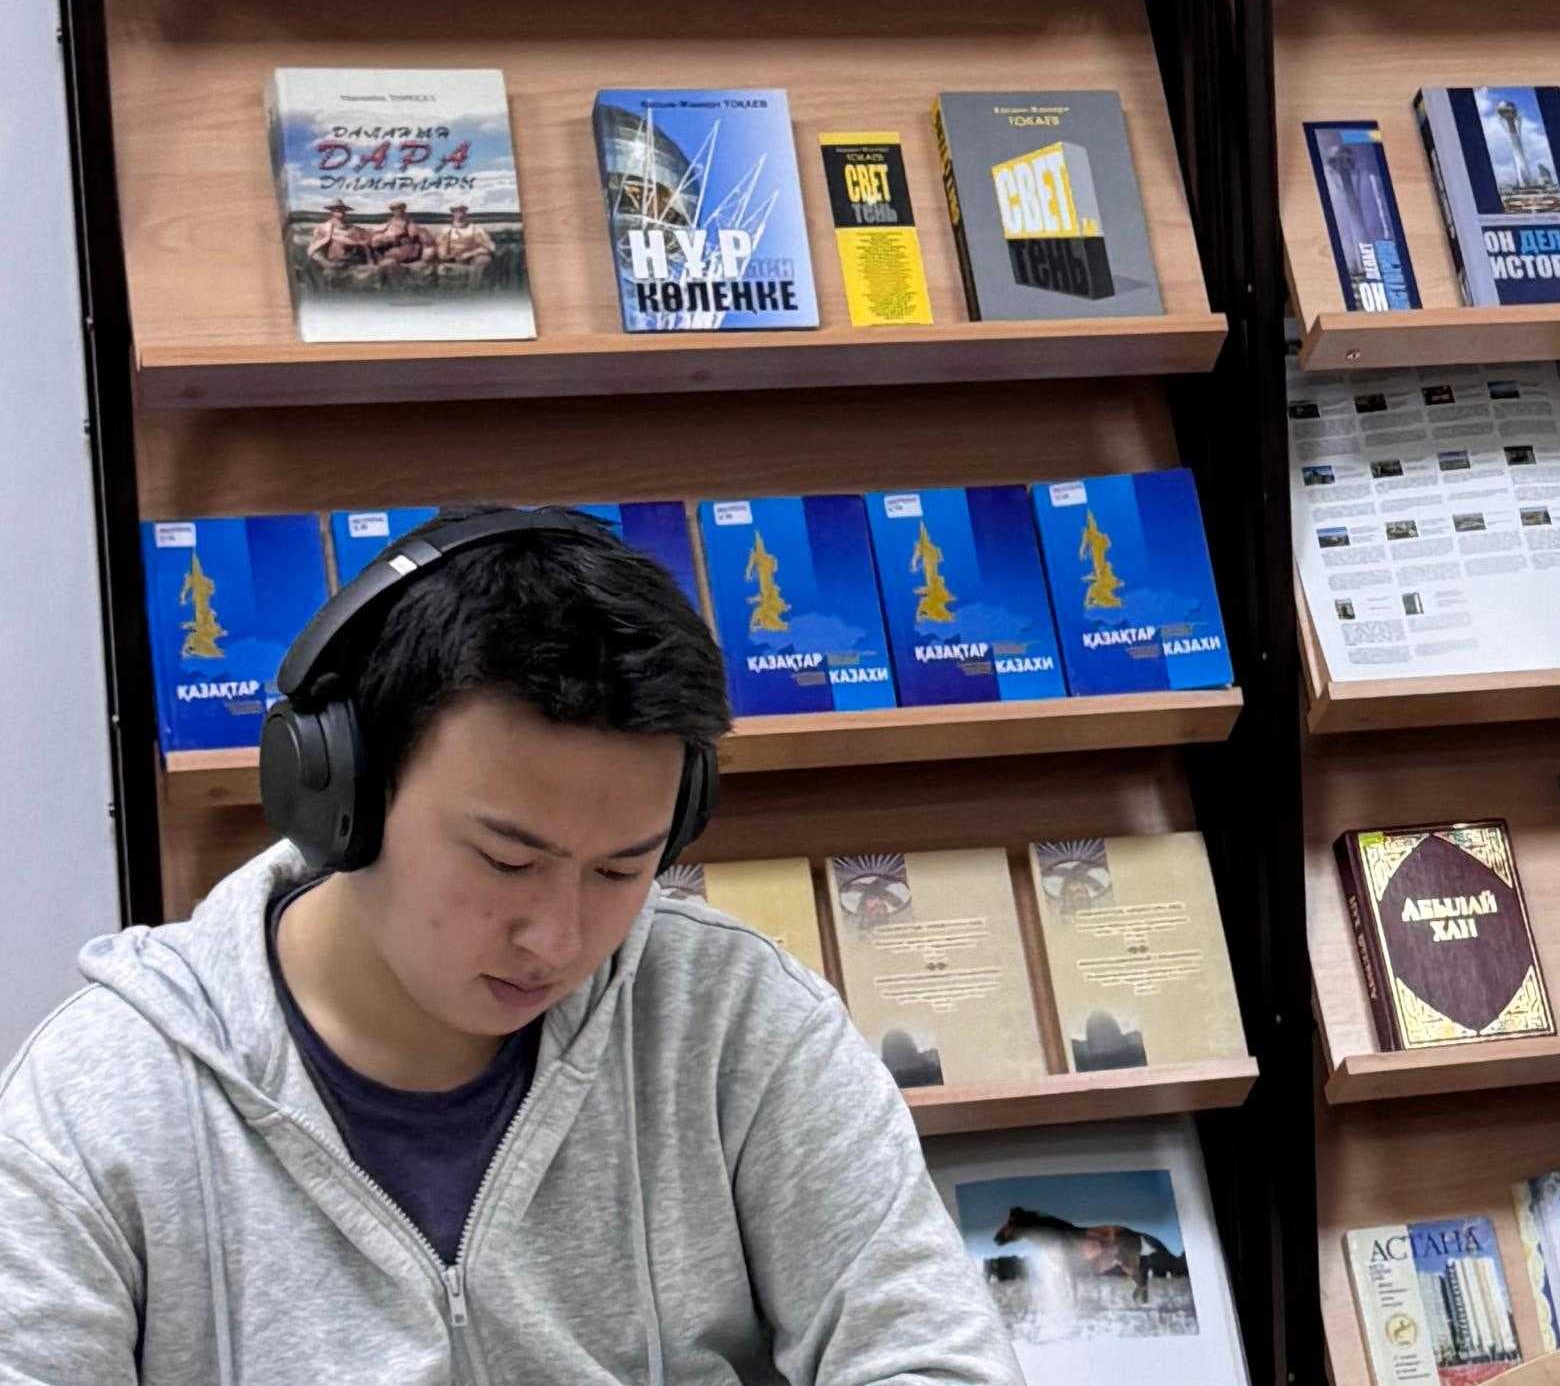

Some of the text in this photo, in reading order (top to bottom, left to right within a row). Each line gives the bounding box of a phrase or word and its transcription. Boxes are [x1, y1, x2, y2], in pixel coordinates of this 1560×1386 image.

[844, 163, 893, 204] СВЕТ
[1485, 230, 1516, 253] ОН
[628, 229, 751, 279] НҰР
[636, 280, 799, 316] КӨЛЕҢКЕ
[1082, 626, 1157, 650] ҚАЗАҚТАР
[1162, 635, 1221, 657] КАЗАХИ
[747, 651, 823, 674] ҚАЗАҚТАР
[914, 642, 989, 664] ҚАЗАҚТАР
[828, 667, 889, 684] КАЗАХИ
[995, 656, 1055, 675] КАЗАХИ
[176, 680, 260, 703] ҚАЗАҚТАР
[1401, 889, 1499, 922] АБЫЛАЙ
[1429, 917, 1479, 943] ХАН
[1369, 1225, 1483, 1263] АСТАНА
